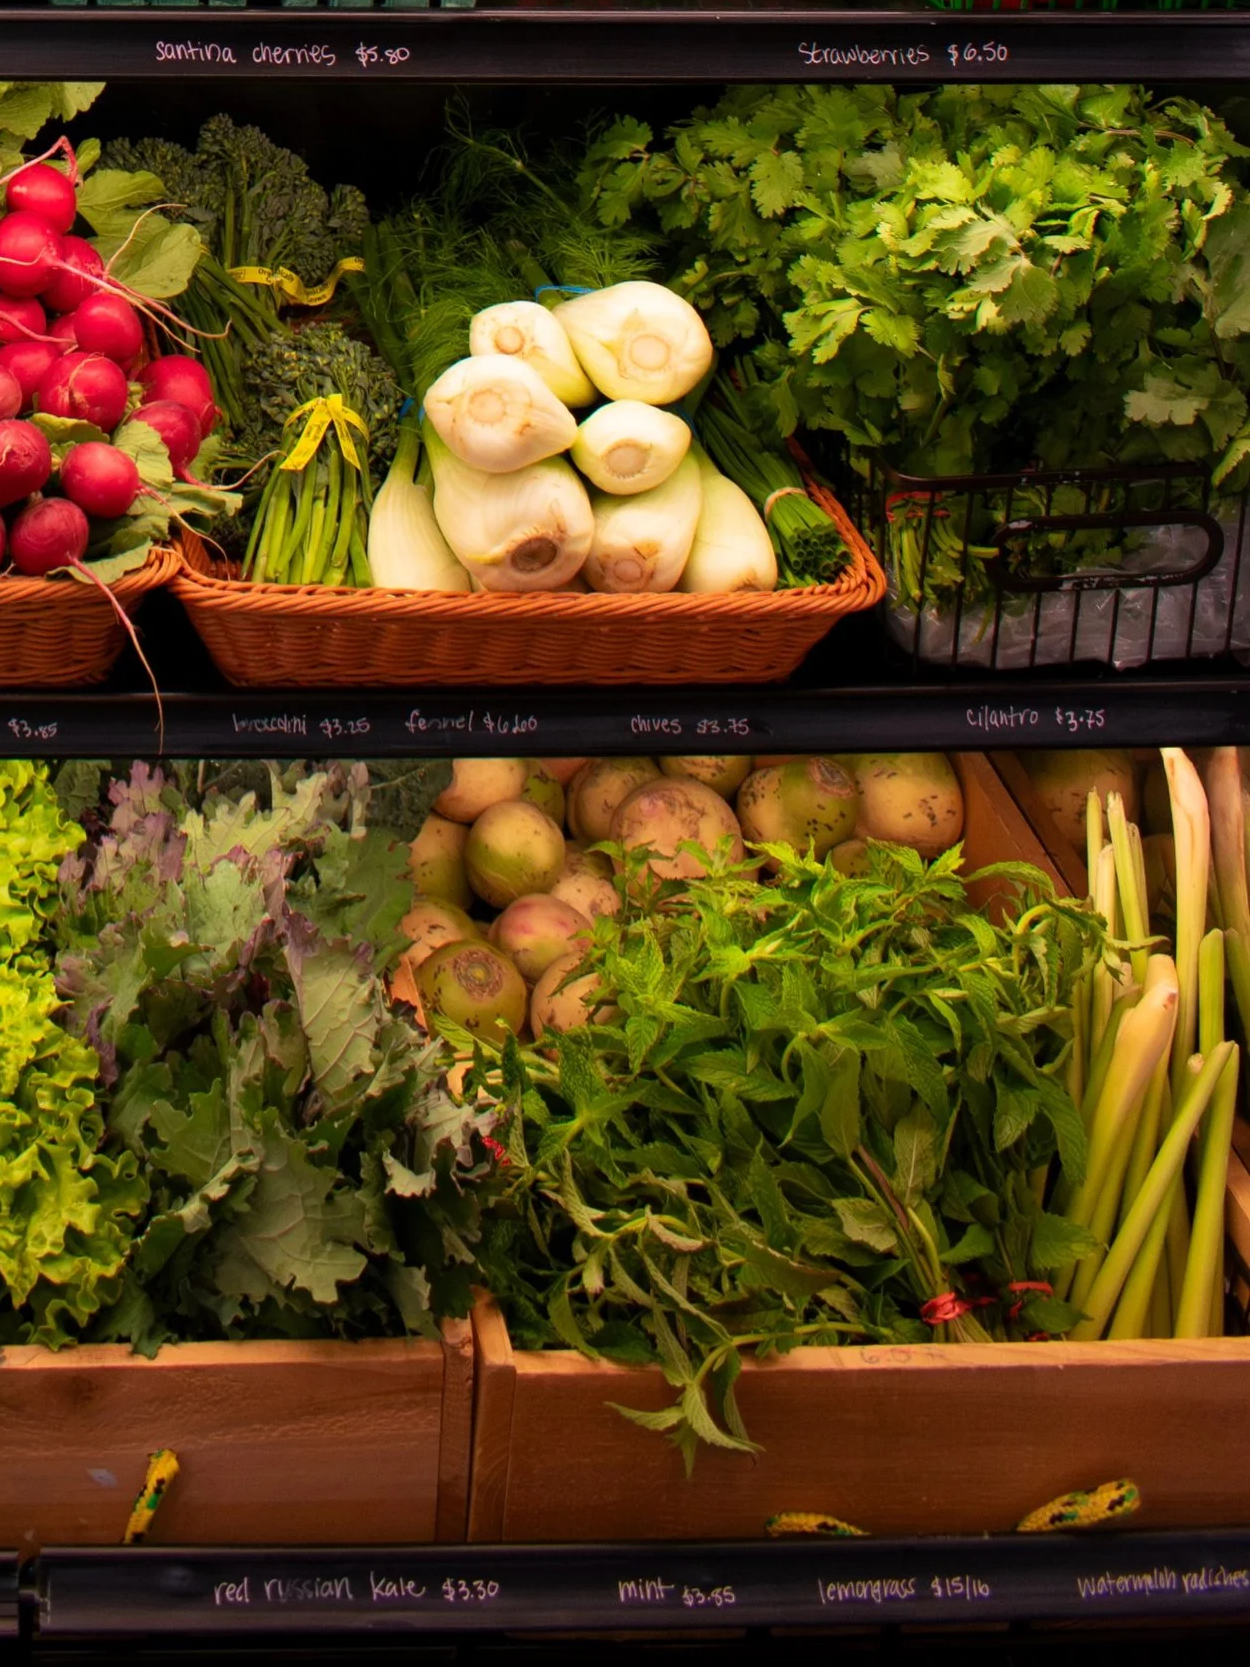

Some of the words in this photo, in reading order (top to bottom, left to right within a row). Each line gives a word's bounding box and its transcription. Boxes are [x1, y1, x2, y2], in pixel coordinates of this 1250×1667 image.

[252, 42, 337, 67] cherries
[355, 41, 411, 68] $5.80
[947, 40, 1009, 67] $6.50
[1055, 706, 1105, 732] $3.75
[214, 1576, 250, 1605] red
[370, 1570, 427, 1602] kale
[441, 1577, 500, 1601] $3.30
[618, 1576, 676, 1603] mint
[817, 1577, 918, 1605] lemongrass
